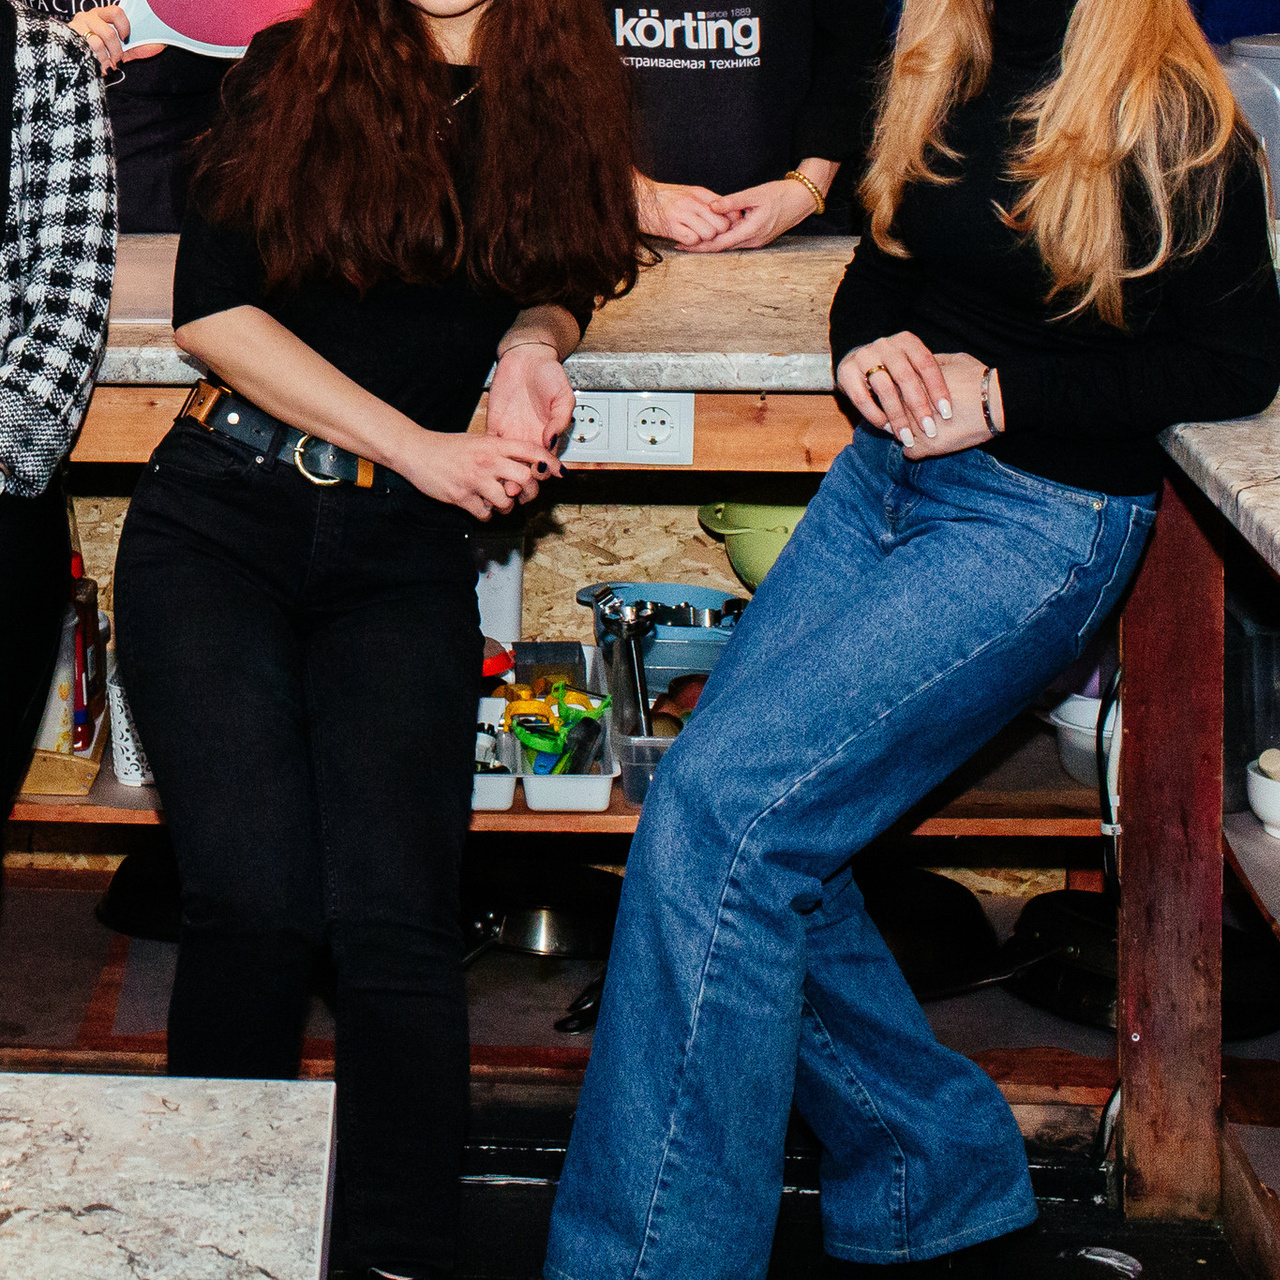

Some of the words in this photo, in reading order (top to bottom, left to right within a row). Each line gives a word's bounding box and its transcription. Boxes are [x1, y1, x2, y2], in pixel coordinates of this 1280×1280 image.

[706, 9, 728, 19] since
[730, 7, 751, 17] 1889
[615, 8, 761, 57] körting
[620, 57, 706, 70] страиваемая
[709, 56, 761, 69] техника
